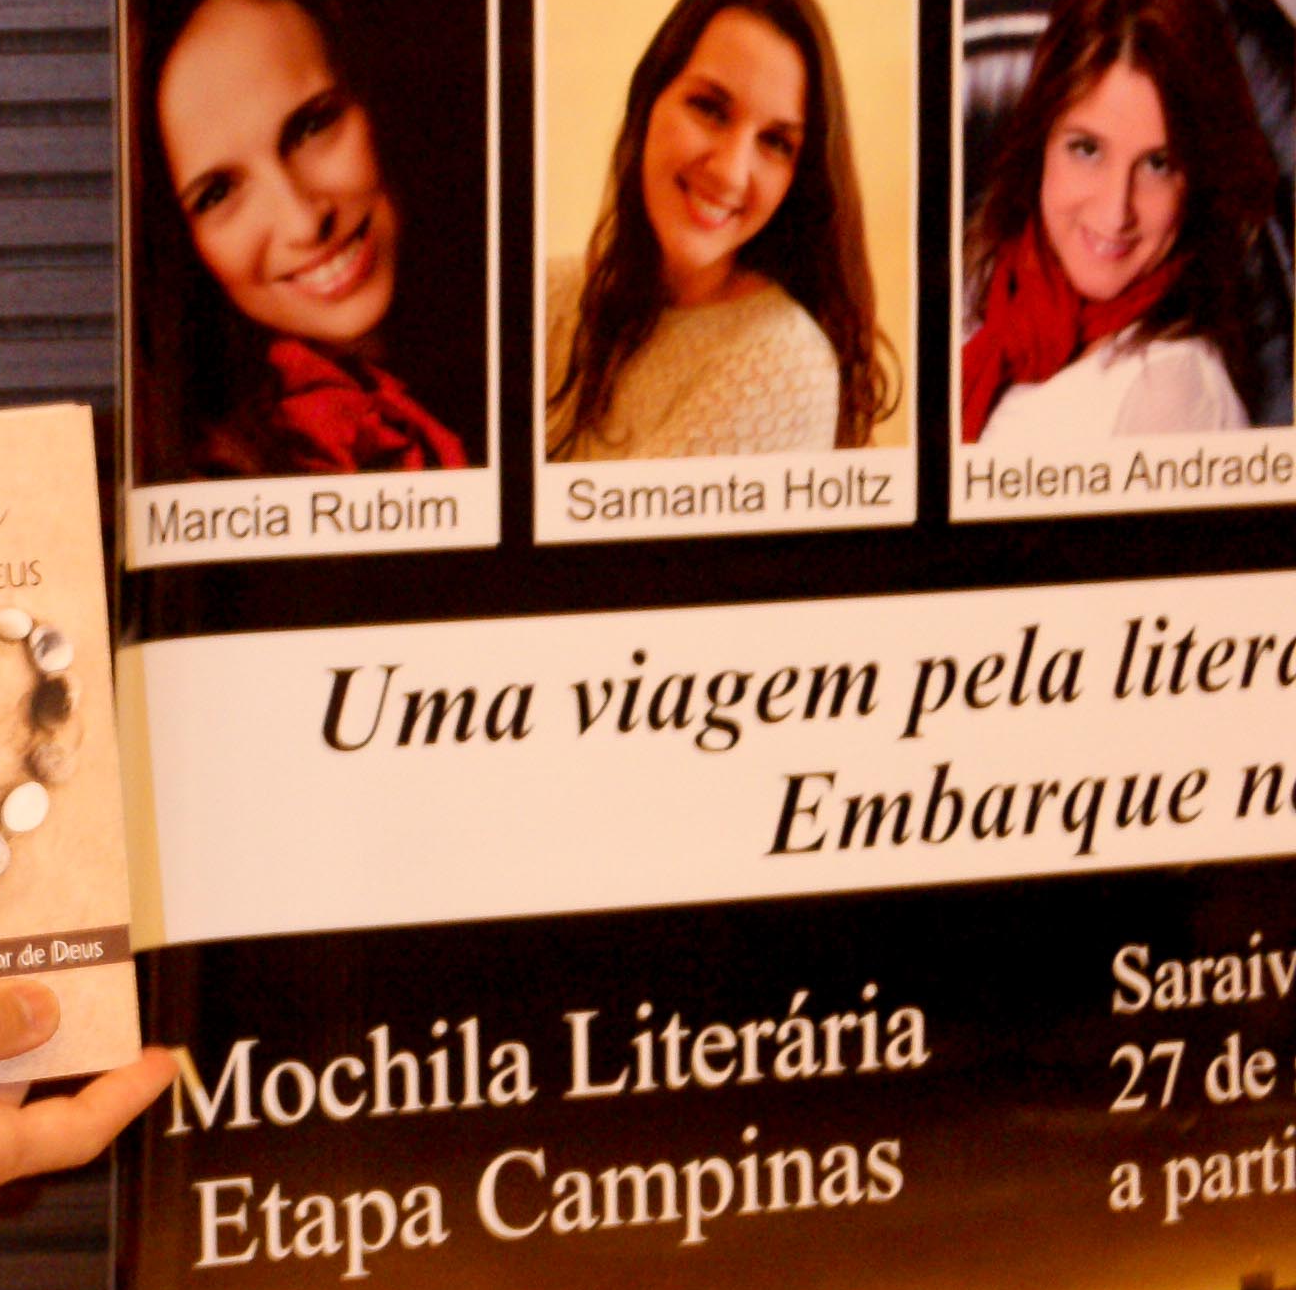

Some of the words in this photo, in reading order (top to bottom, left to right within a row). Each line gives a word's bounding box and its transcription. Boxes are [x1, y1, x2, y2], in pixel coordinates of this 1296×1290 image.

[567, 475, 765, 522] Samanta
[785, 467, 892, 510] Holtz
[966, 458, 1111, 501] Helena
[1124, 446, 1295, 492] Andrade
[148, 493, 291, 546] Marcia
[311, 488, 459, 534] Rubim
[320, 662, 535, 753] Uma
[569, 649, 881, 751] viagem
[901, 624, 1084, 739] pela
[764, 759, 1209, 857] Embarque
[1235, 761, 1296, 819] n
[18, 944, 45, 967] de
[52, 938, 104, 964] Deus
[164, 1013, 536, 1137] Mochila
[563, 982, 932, 1103] Literária
[1109, 1040, 1186, 1114] 27
[1205, 1032, 1277, 1104] de
[193, 1174, 451, 1281] Etapa
[477, 1126, 905, 1246] Campinas
[1108, 1160, 1144, 1212] a
